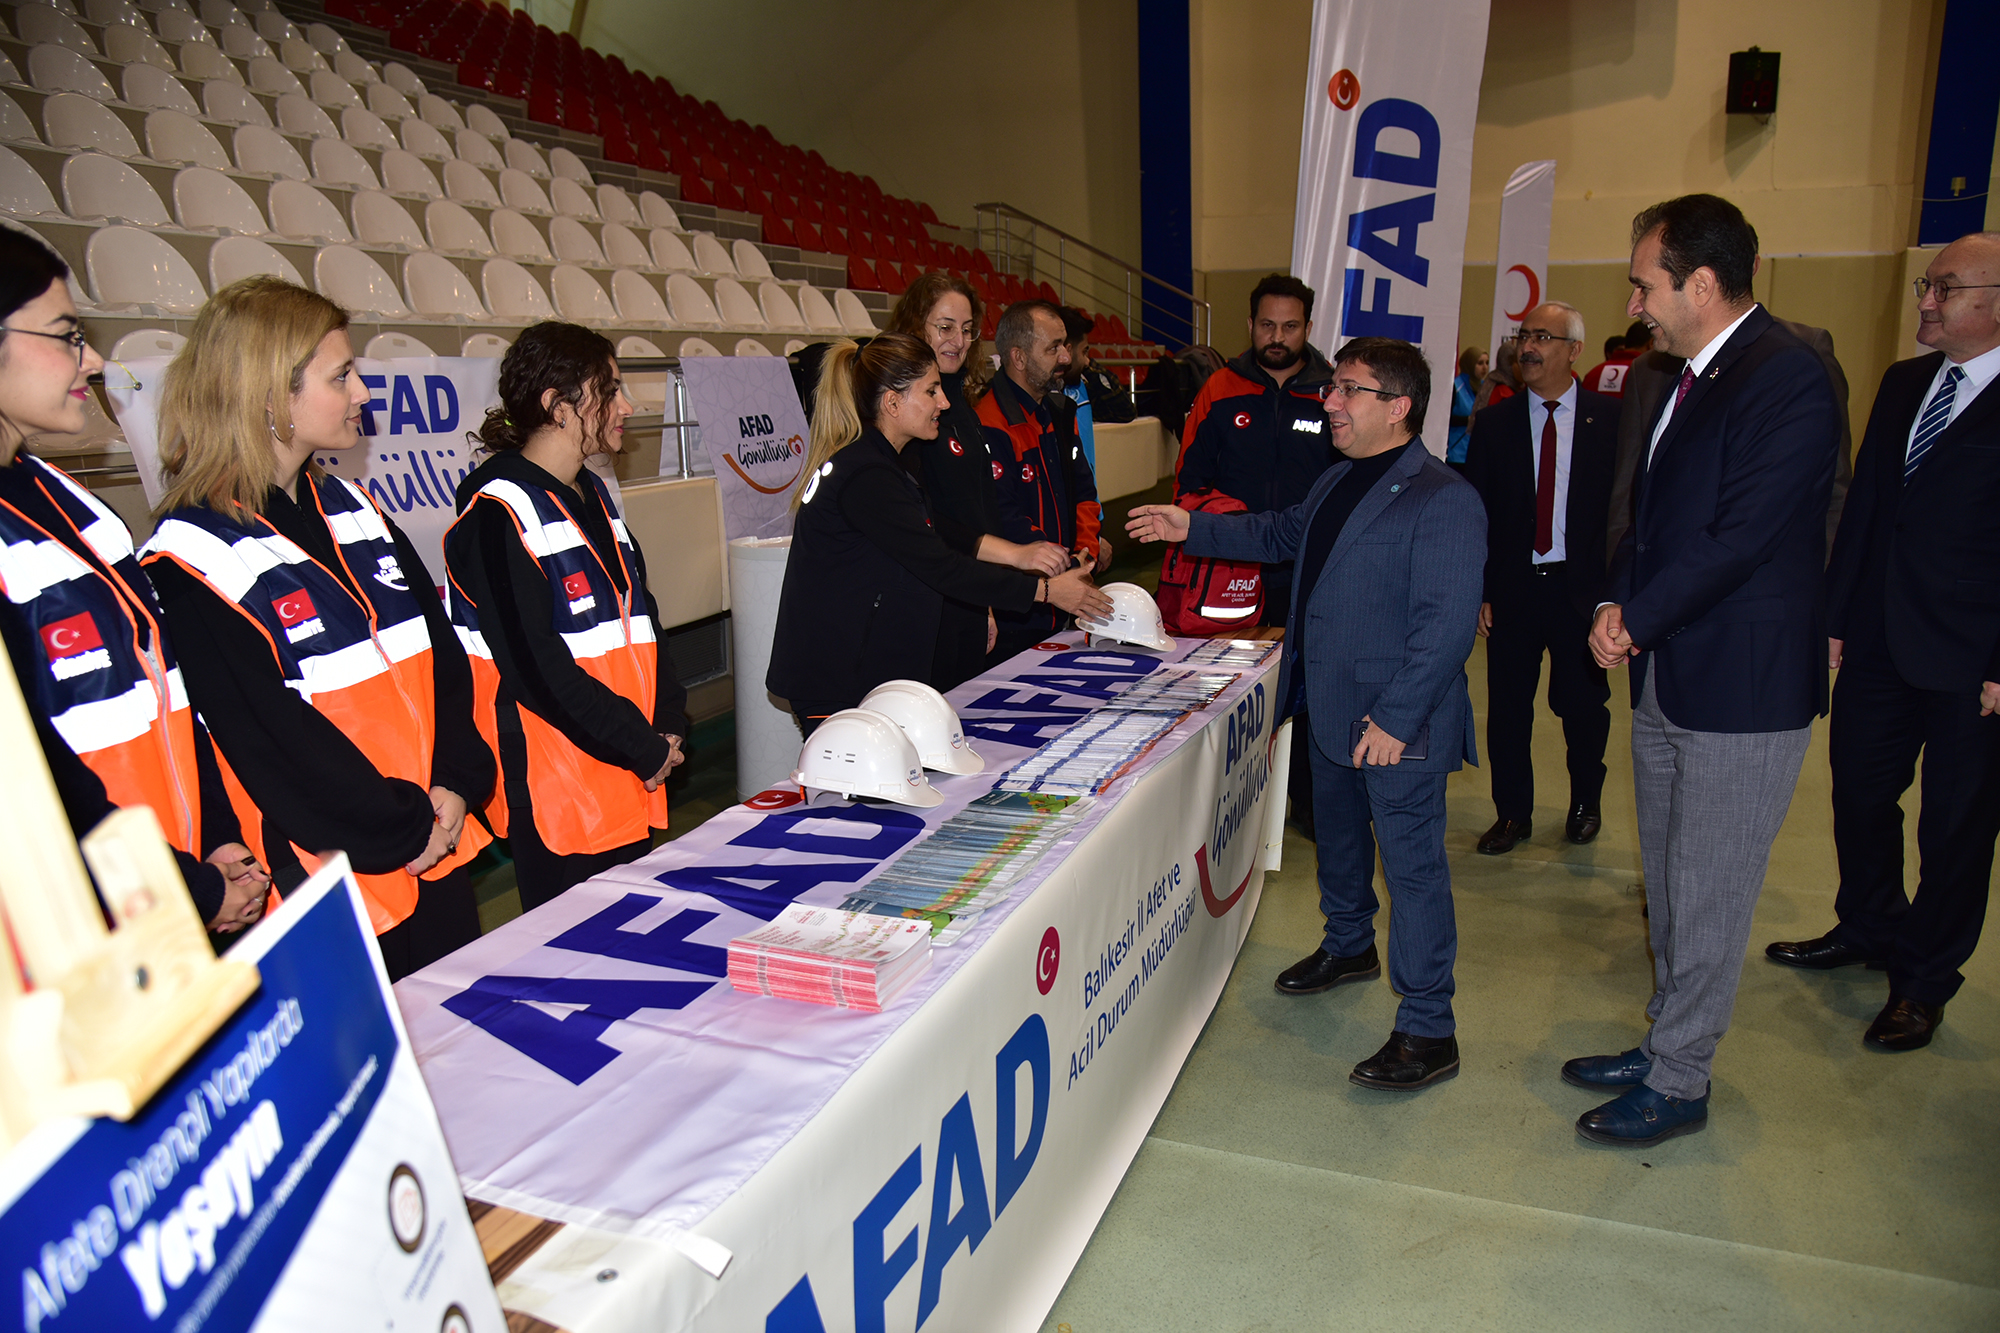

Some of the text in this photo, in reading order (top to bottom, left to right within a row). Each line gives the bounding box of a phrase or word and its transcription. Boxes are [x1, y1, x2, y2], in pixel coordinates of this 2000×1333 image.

[1340, 97, 1441, 352] FAD
[357, 374, 460, 437] FAD
[738, 413, 775, 439] AFAD
[1226, 579, 1256, 592] AFAD
[1225, 681, 1266, 777] AFAD
[440, 803, 927, 1086] AFAD
[1067, 886, 1197, 1092] Acil Durum Müdürlüğü
[1084, 862, 1181, 1011] Balıkesir İl Afet ve
